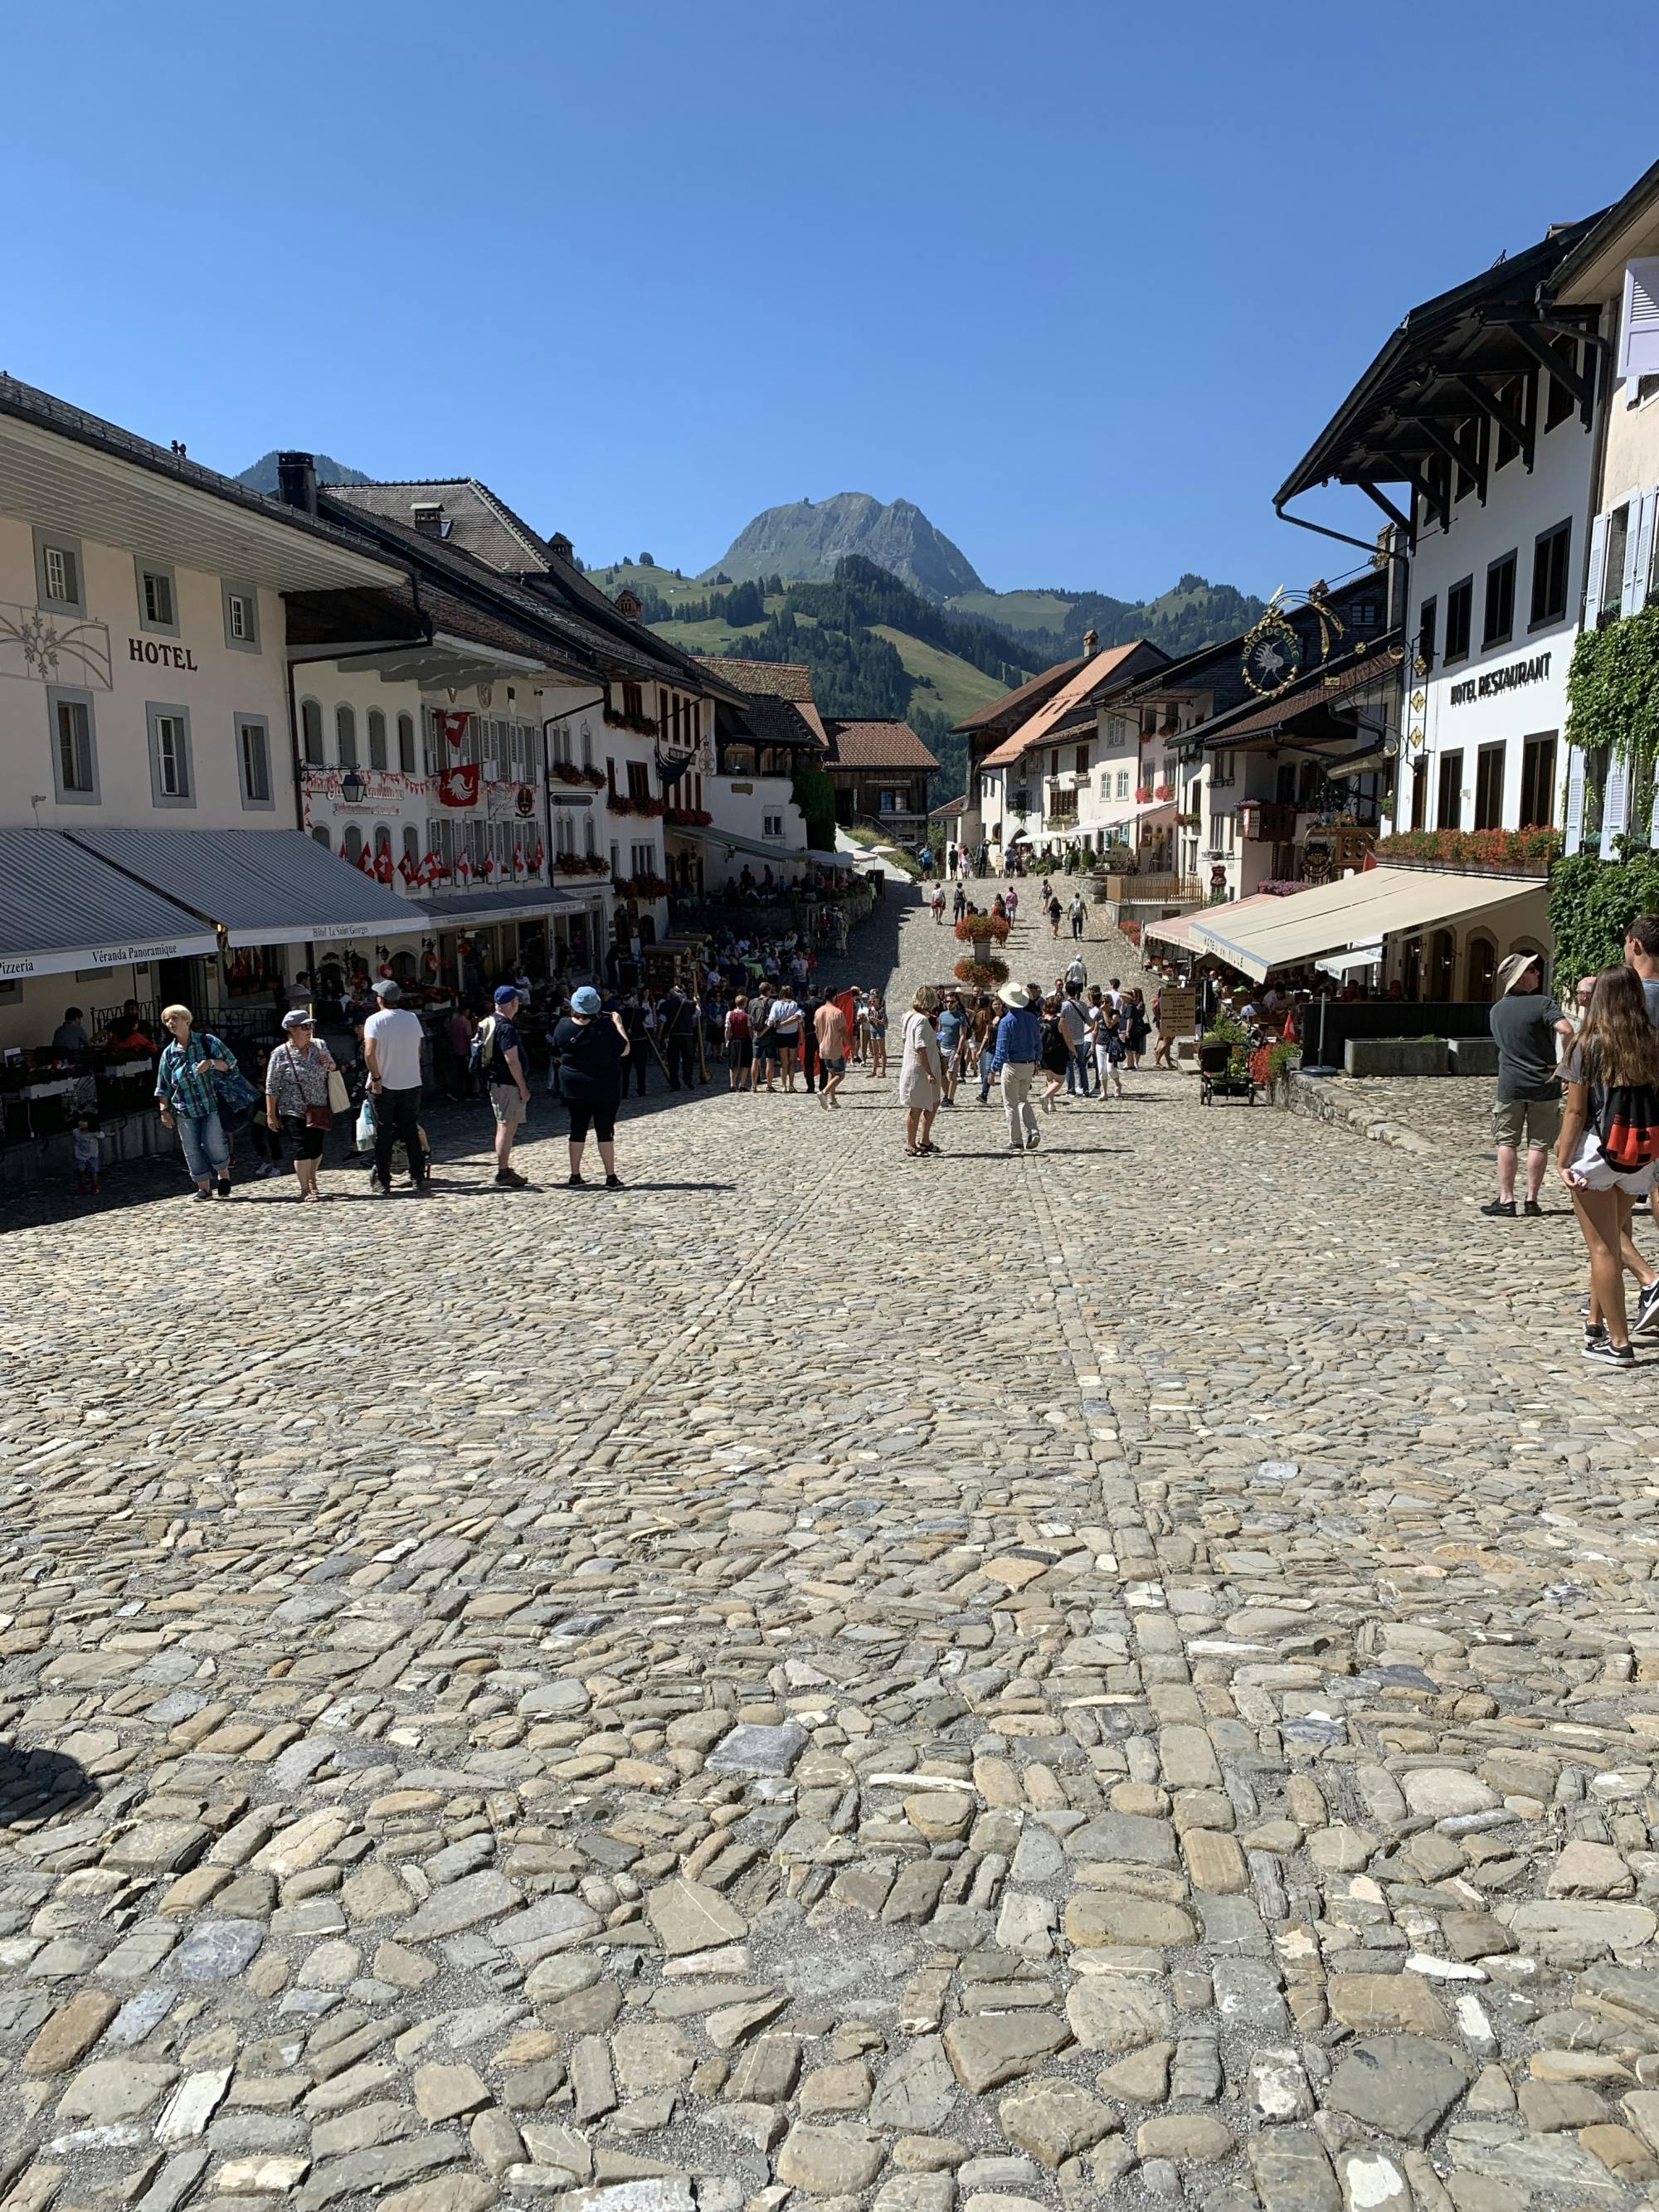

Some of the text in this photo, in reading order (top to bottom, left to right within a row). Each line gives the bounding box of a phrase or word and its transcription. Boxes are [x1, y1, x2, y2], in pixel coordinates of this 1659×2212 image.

[128, 638, 198, 672] HOTEL
[1241, 628, 1300, 660] HOTEL DE VILLE
[1450, 651, 1552, 707] HOTEL RESTAURANT
[313, 926, 327, 937] Hôtel
[328, 926, 336, 936] Le
[92, 949, 127, 963] Véranda
[129, 944, 178, 959] Panoramique
